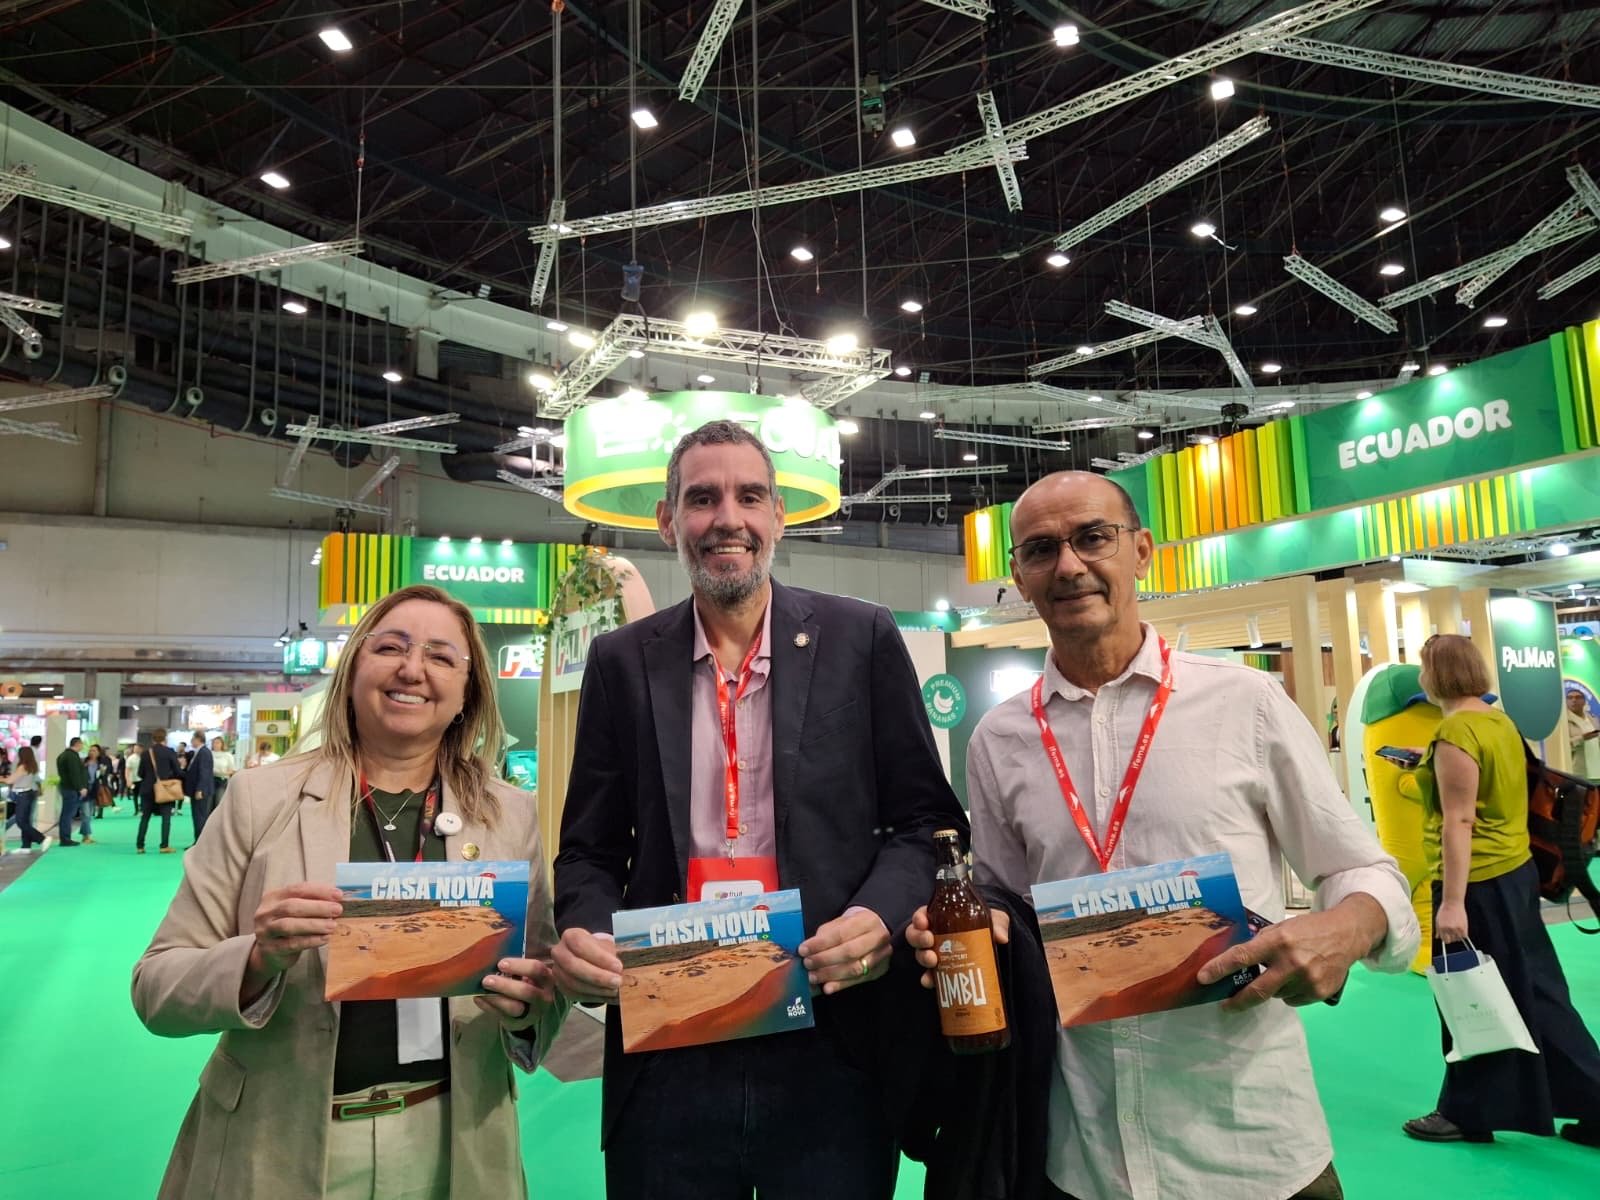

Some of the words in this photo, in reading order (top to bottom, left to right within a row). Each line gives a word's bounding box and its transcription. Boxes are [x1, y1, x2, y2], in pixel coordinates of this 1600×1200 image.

[1338, 399, 1512, 469] ECUADOR
[423, 564, 525, 583] ECUADOR
[930, 680, 960, 700] PREMIUM
[925, 702, 956, 723] BANANAS
[1049, 745, 1065, 779] ifema.es
[1132, 734, 1150, 769] ifema.es
[1104, 820, 1121, 858] ifema.es
[371, 877, 430, 900] CASA
[436, 876, 494, 899] NOVA
[1071, 889, 1136, 918] CASA
[1136, 876, 1202, 907] NOVA
[650, 916, 708, 946] CASA
[711, 911, 770, 939] NOVA
[936, 968, 987, 1008] UMBU
[787, 1004, 805, 1012] CASA
[788, 1009, 806, 1017] NOVA
